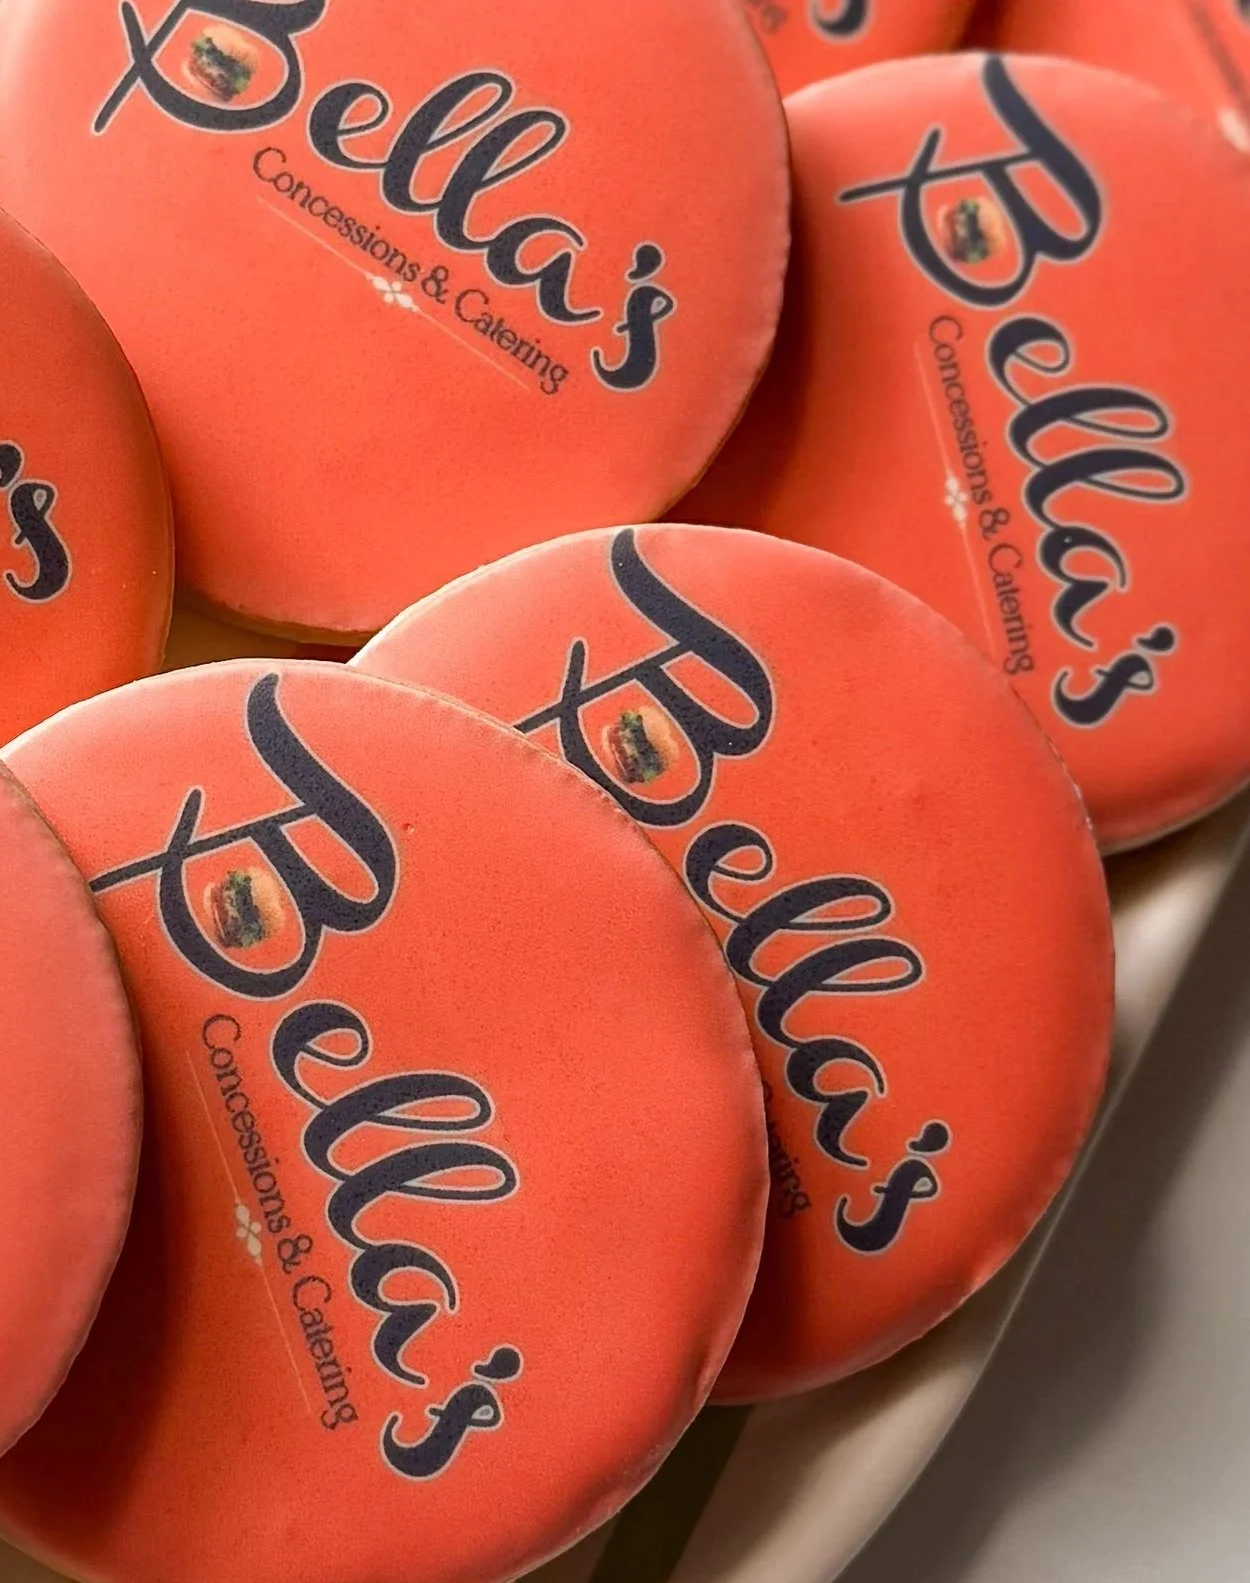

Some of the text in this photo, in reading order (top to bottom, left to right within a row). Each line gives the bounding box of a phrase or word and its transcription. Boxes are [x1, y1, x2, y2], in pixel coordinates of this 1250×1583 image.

[253, 146, 570, 396] Concessions & Catering
[835, 52, 1190, 728] Bella's
[928, 314, 1035, 676] Concessions & Catering
[89, 671, 523, 1482] Bella's
[514, 527, 953, 1257] Bella's
[201, 1013, 359, 1431] Concessions & Catering
